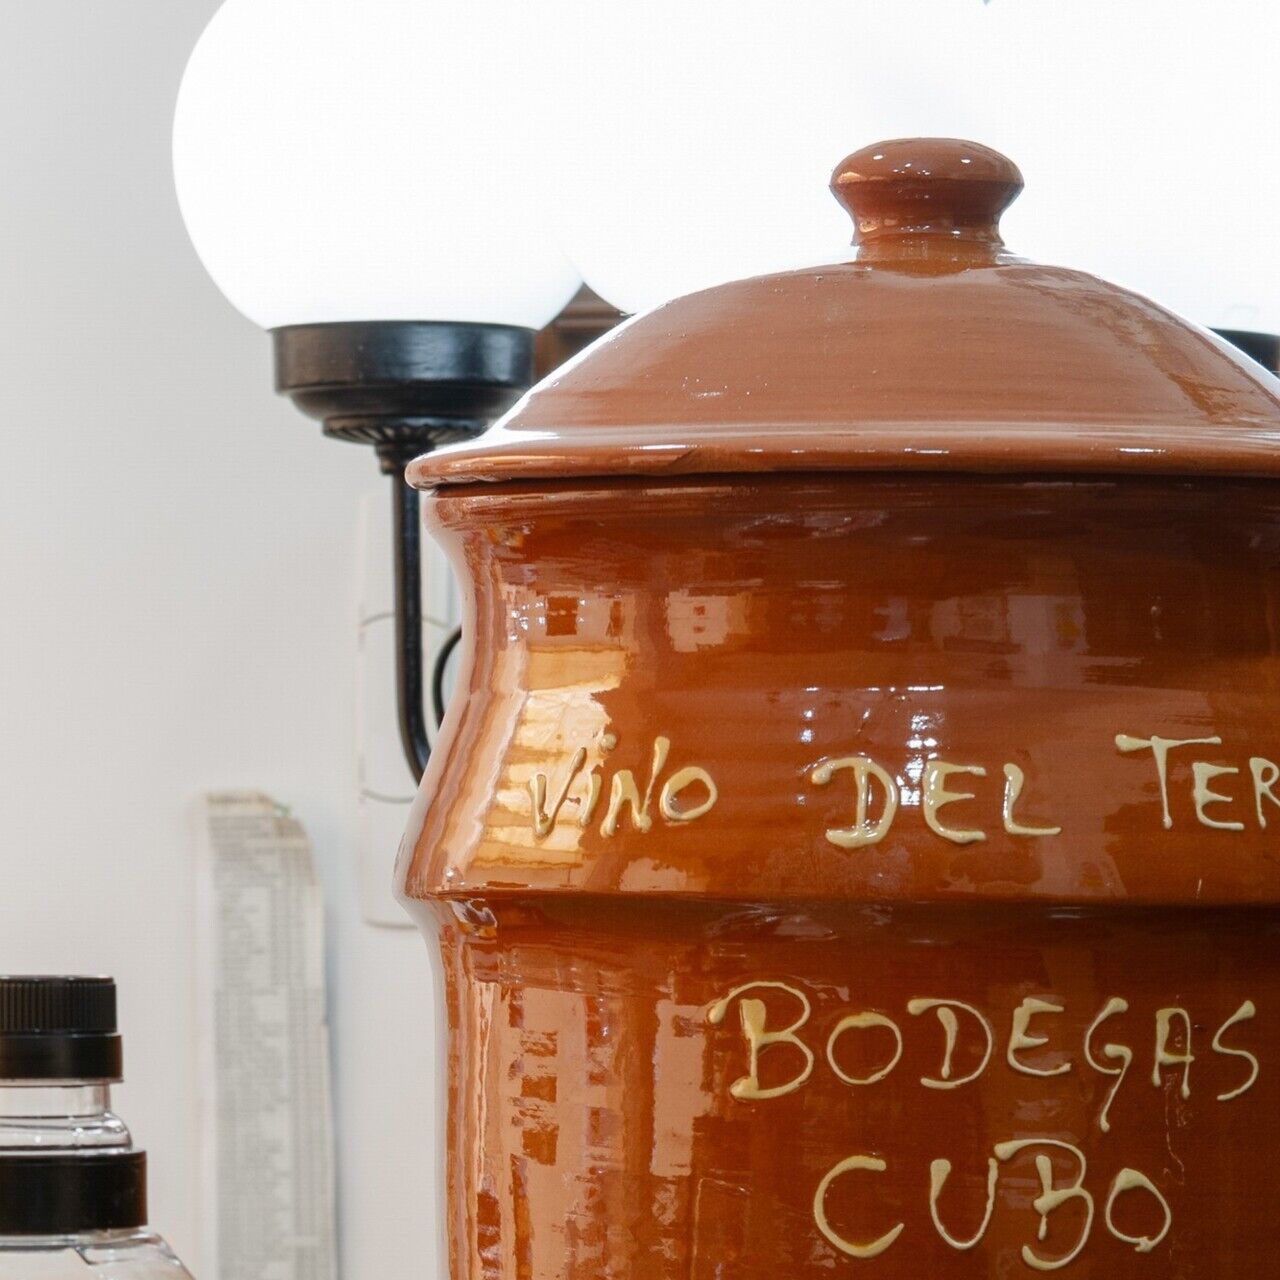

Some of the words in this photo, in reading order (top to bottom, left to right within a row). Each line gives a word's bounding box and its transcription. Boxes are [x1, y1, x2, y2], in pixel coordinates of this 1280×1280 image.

[811, 756, 1061, 850] DEL
[708, 981, 1259, 1132] BODEGAS
[814, 1138, 1171, 1270] CUBO
